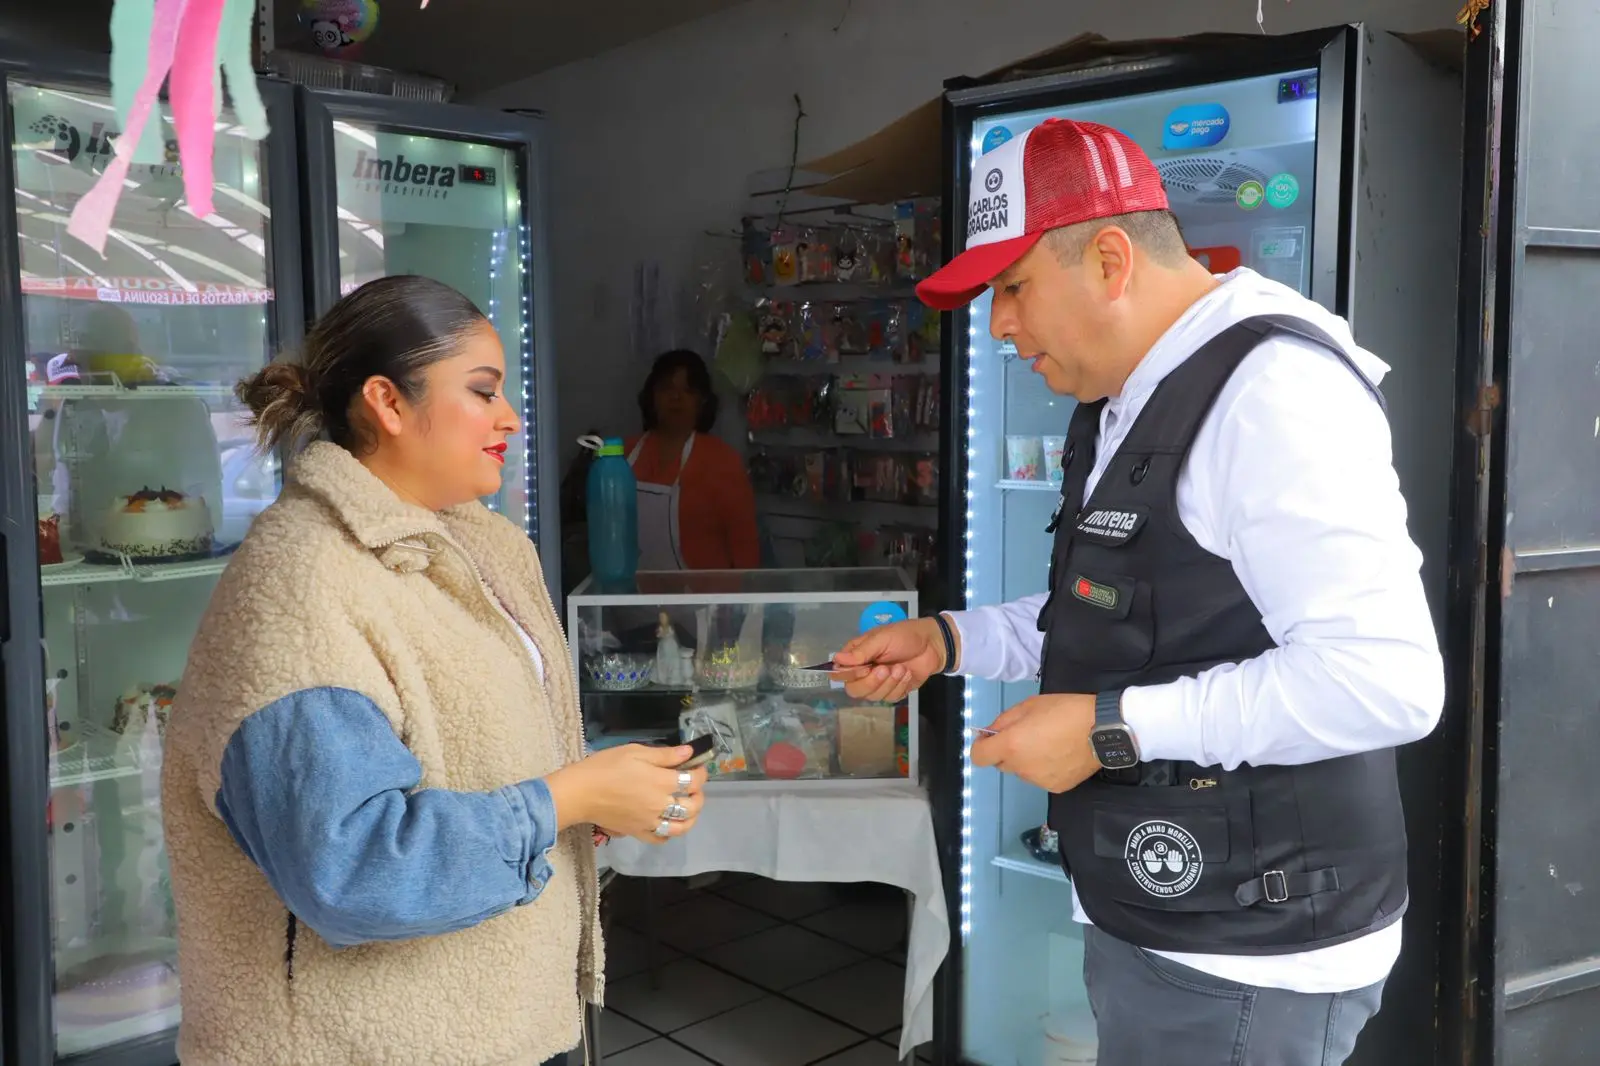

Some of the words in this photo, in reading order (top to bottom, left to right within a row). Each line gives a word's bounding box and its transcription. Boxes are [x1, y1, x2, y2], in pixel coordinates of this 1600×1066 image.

[1191, 126, 1210, 135] pago
[1192, 118, 1225, 127] mercado
[353, 149, 455, 187] Imbera
[973, 193, 1008, 216] CARLOS
[967, 209, 1008, 238] RRAGAN
[1084, 511, 1138, 530] morena
[1130, 832, 1142, 849] MANO
[1146, 825, 1166, 834] MANO
[1167, 827, 1194, 850] MORELIA
[1131, 861, 1173, 894] CONSTRUYENDO
